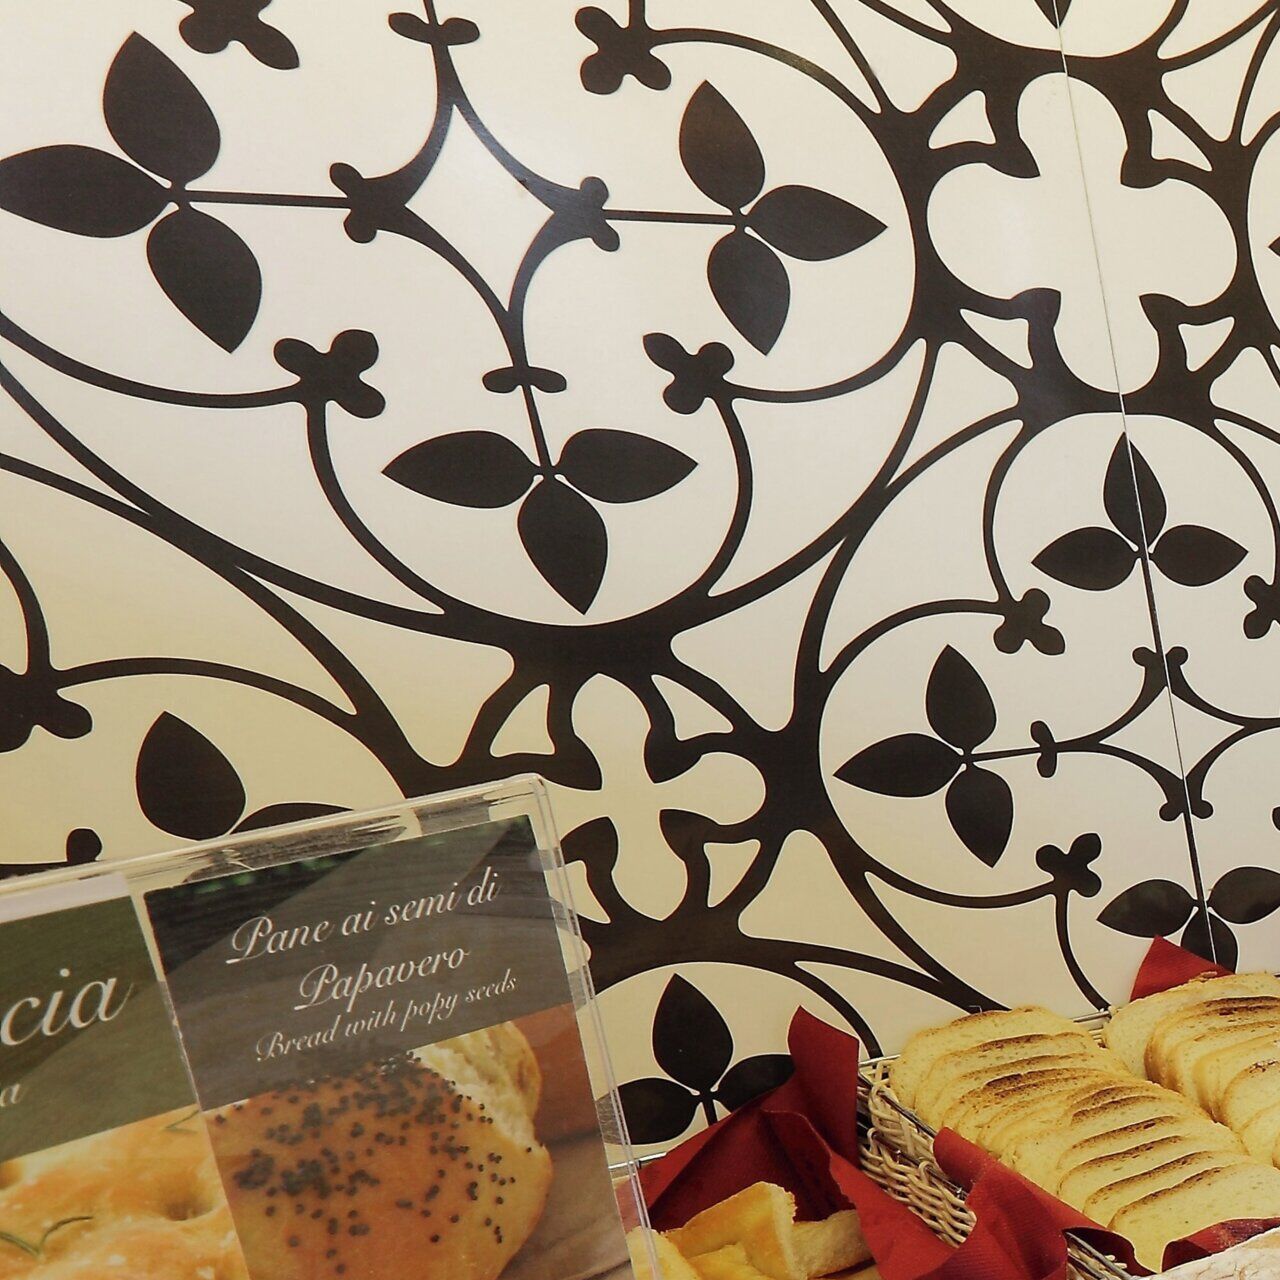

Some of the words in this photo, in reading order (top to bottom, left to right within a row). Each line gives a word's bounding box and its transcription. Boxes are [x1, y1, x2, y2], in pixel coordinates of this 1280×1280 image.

[226, 915, 335, 965] Pane
[342, 901, 377, 936] ai
[384, 882, 460, 925] semi
[467, 866, 500, 906] di
[0, 968, 134, 1046] cia
[256, 1014, 342, 1062] Bread
[345, 1000, 396, 1037] with
[400, 992, 458, 1032] popy
[465, 968, 517, 1003] seeds
[294, 947, 471, 1013] Papavero
